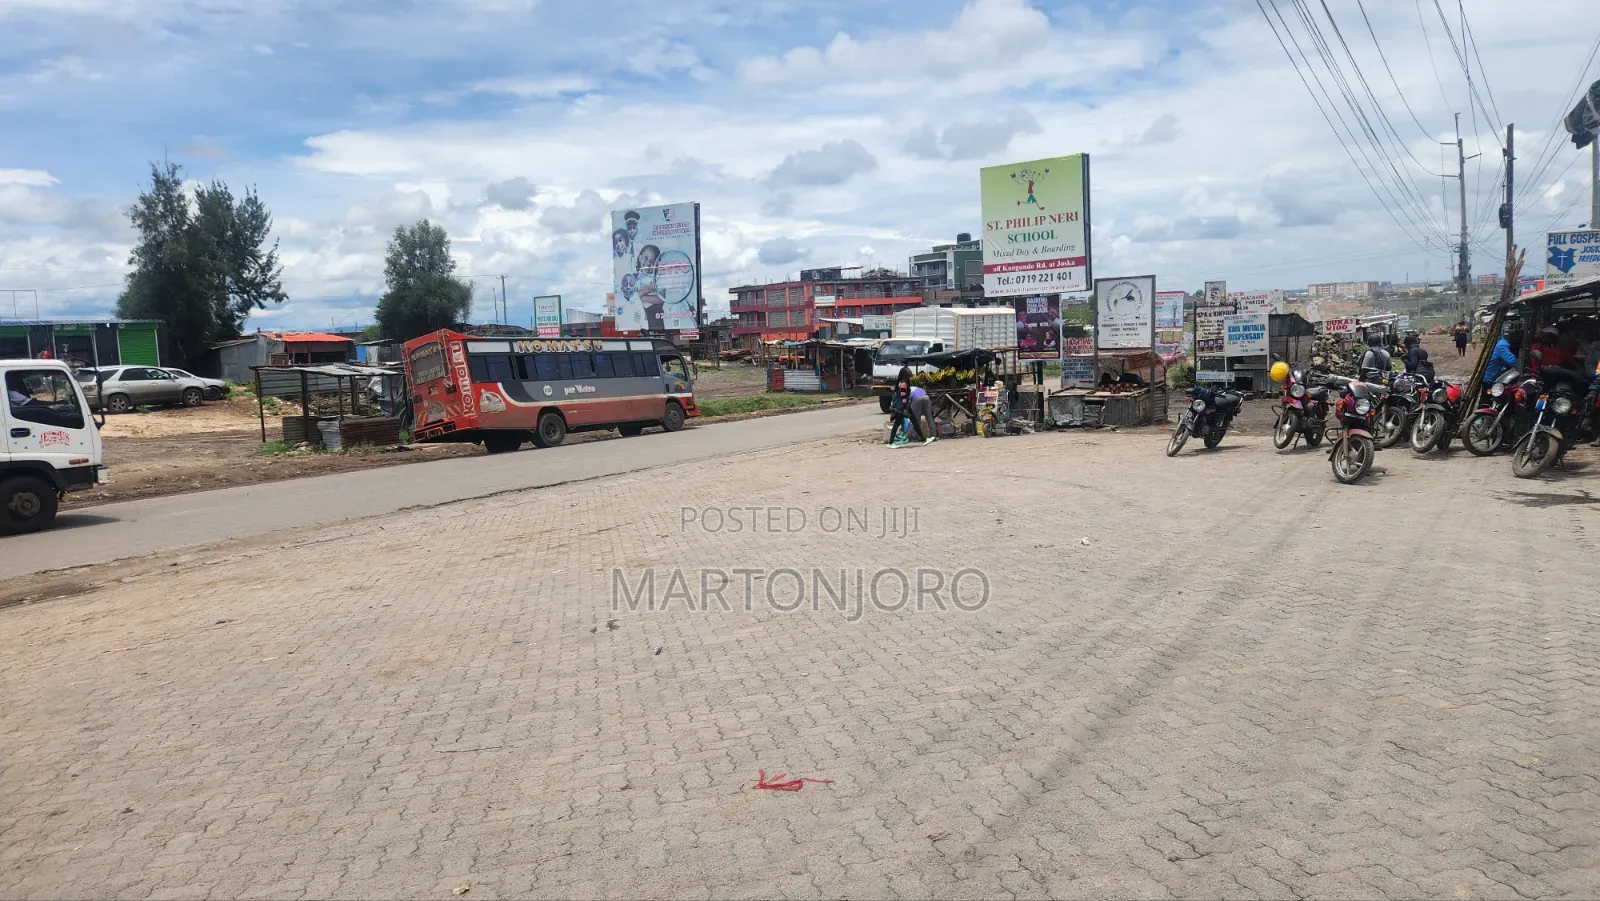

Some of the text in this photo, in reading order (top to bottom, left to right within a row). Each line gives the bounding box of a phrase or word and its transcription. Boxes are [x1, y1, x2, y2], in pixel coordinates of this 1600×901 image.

[986, 211, 1079, 231] ST. PHILIP NERI
[1007, 229, 1058, 244] SCHOOL
[1548, 232, 1600, 245] FULL GOSPE
[992, 243, 1076, 258] Mixed Day & Boarding
[1002, 262, 1035, 272] Kangundo
[1057, 259, 1075, 267] Joska
[997, 271, 1072, 286] Tel.: 0719 221 401
[1228, 324, 1266, 333] KWA MUTALIA
[1227, 332, 1265, 341] DISPENSARY
[516, 339, 604, 354] KOMATSU
[39, 430, 70, 444] JEUS
